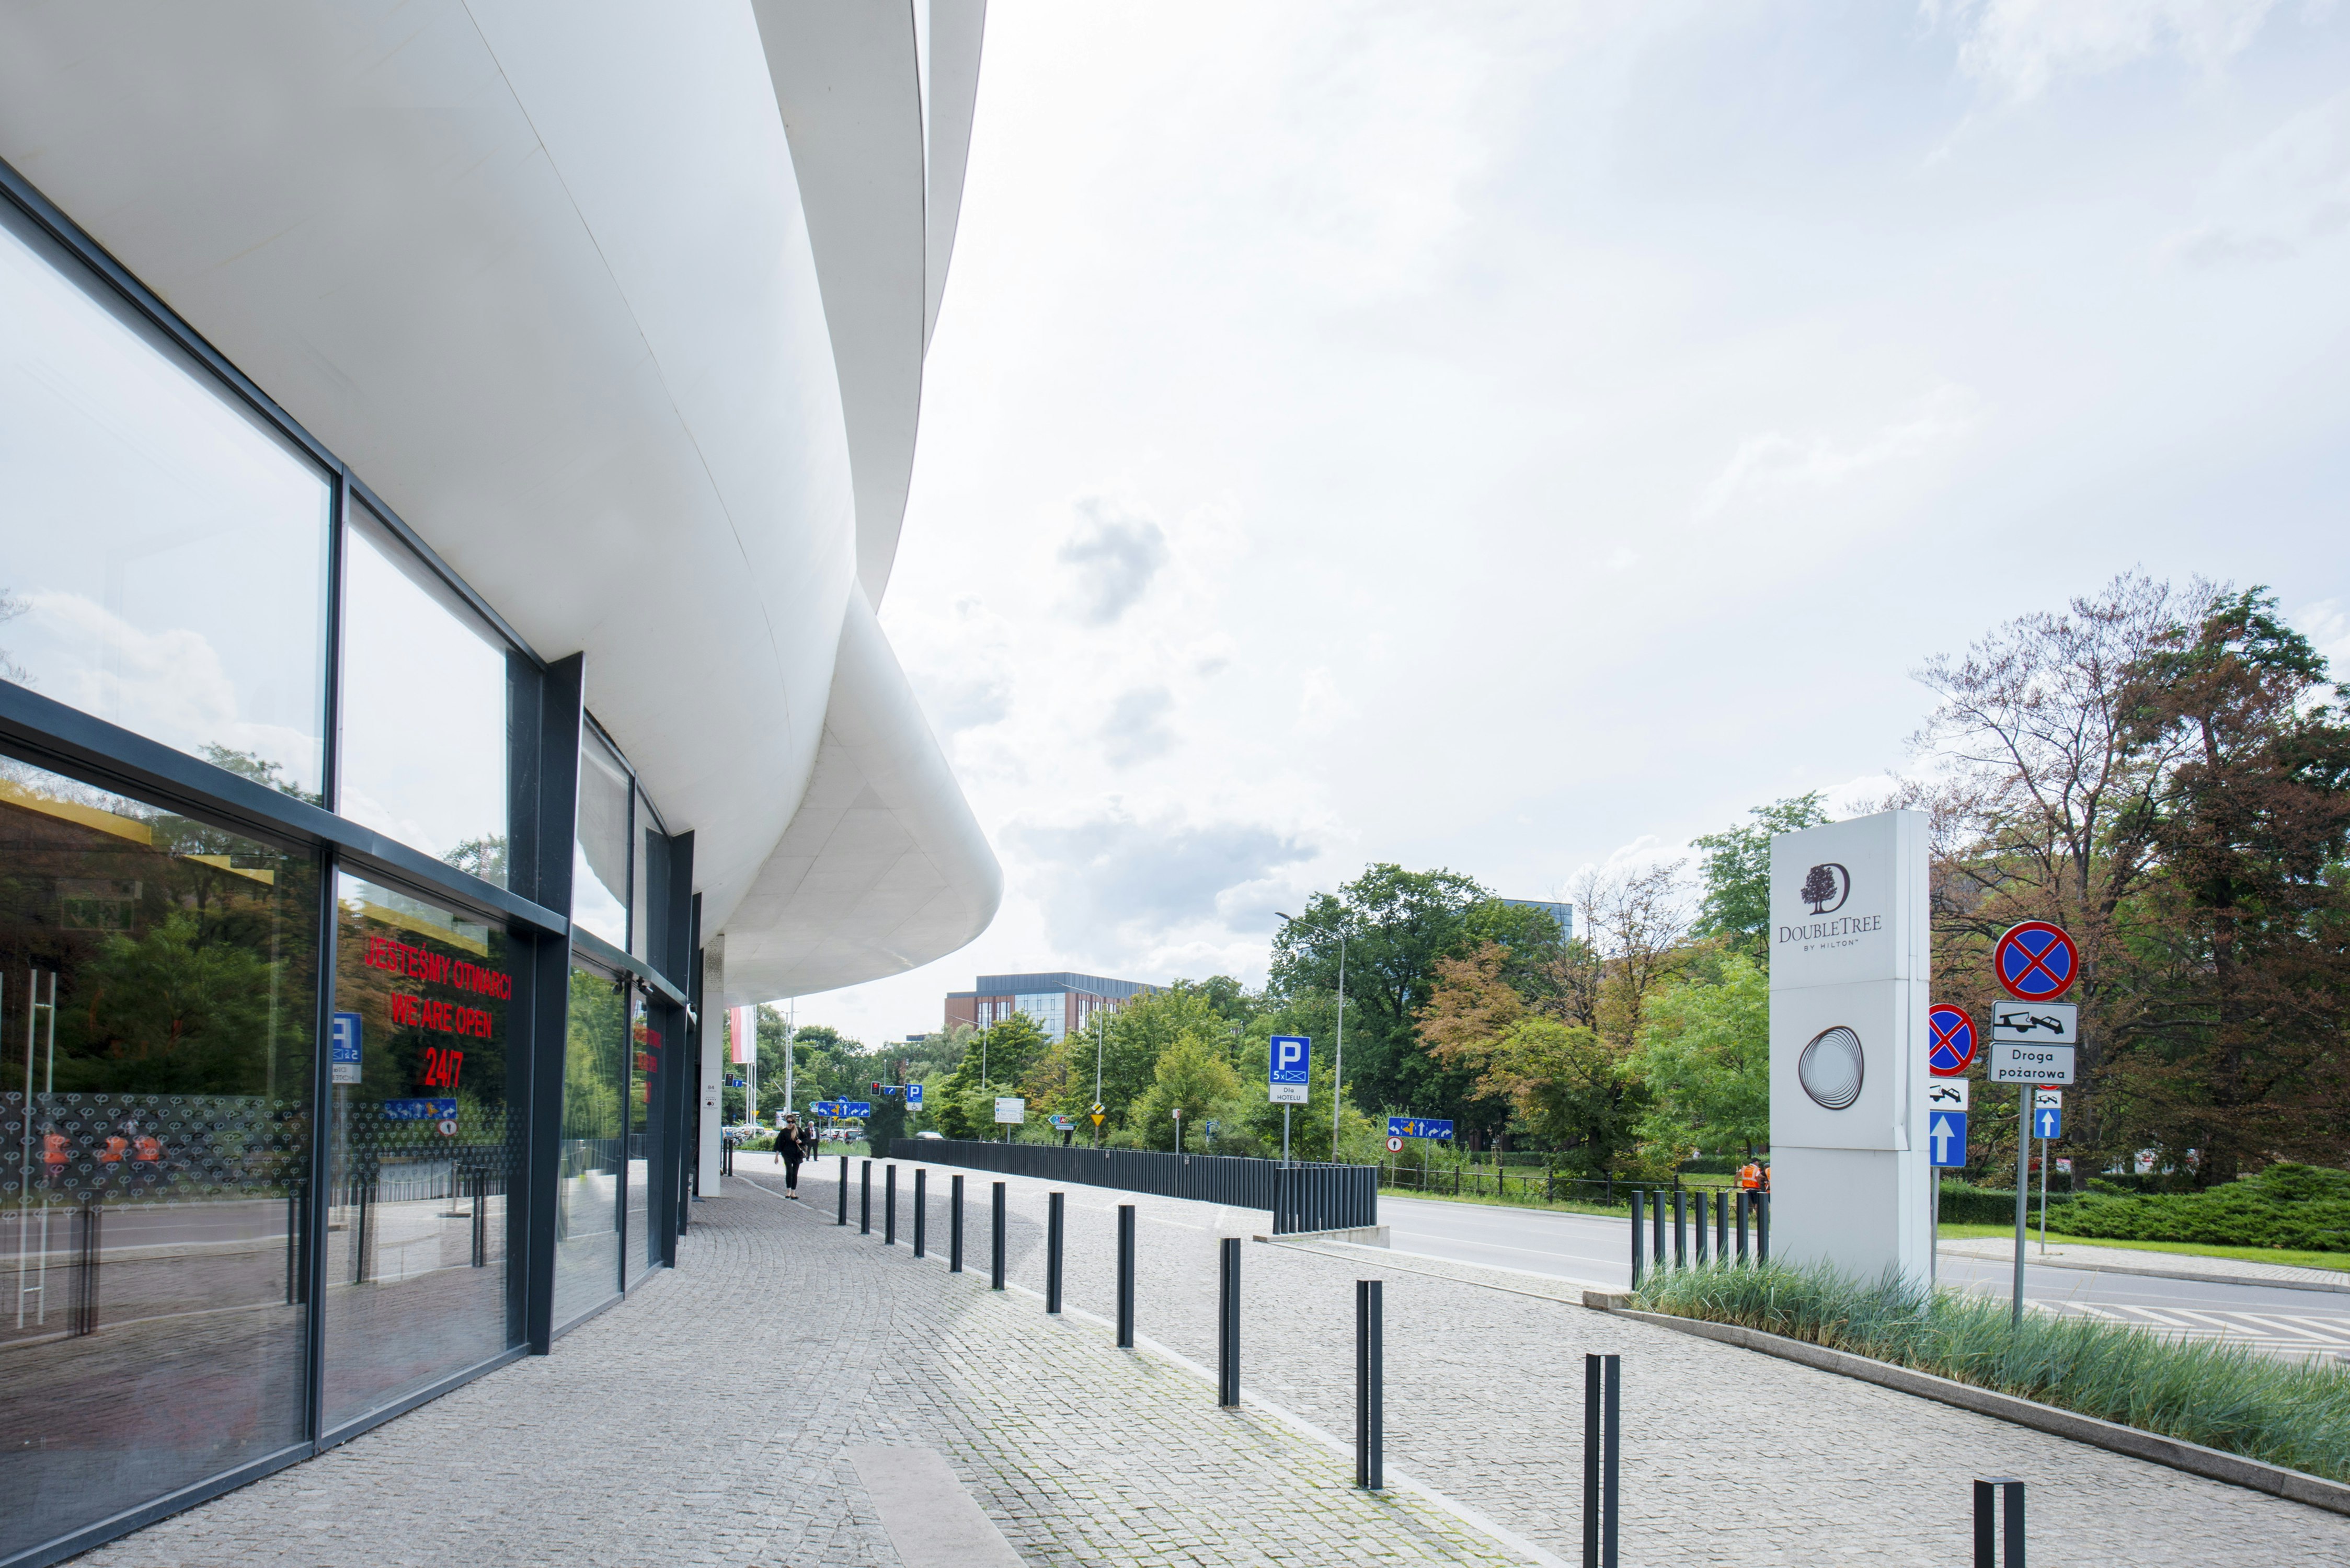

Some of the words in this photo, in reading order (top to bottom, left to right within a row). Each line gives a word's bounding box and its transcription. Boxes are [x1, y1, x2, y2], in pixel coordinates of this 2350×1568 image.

[365, 936, 451, 985] JESTEŚMY
[453, 960, 512, 1000] OTWARCI
[392, 992, 418, 1026] WE
[421, 999, 452, 1032] ARE
[456, 1006, 492, 1038] OPEN
[425, 1047, 463, 1088] 24/7
[1279, 1041, 1301, 1070] P
[2012, 1050, 2053, 1064] Droga
[1999, 1067, 2065, 1079] pożarowa
[910, 1086, 920, 1098] P
